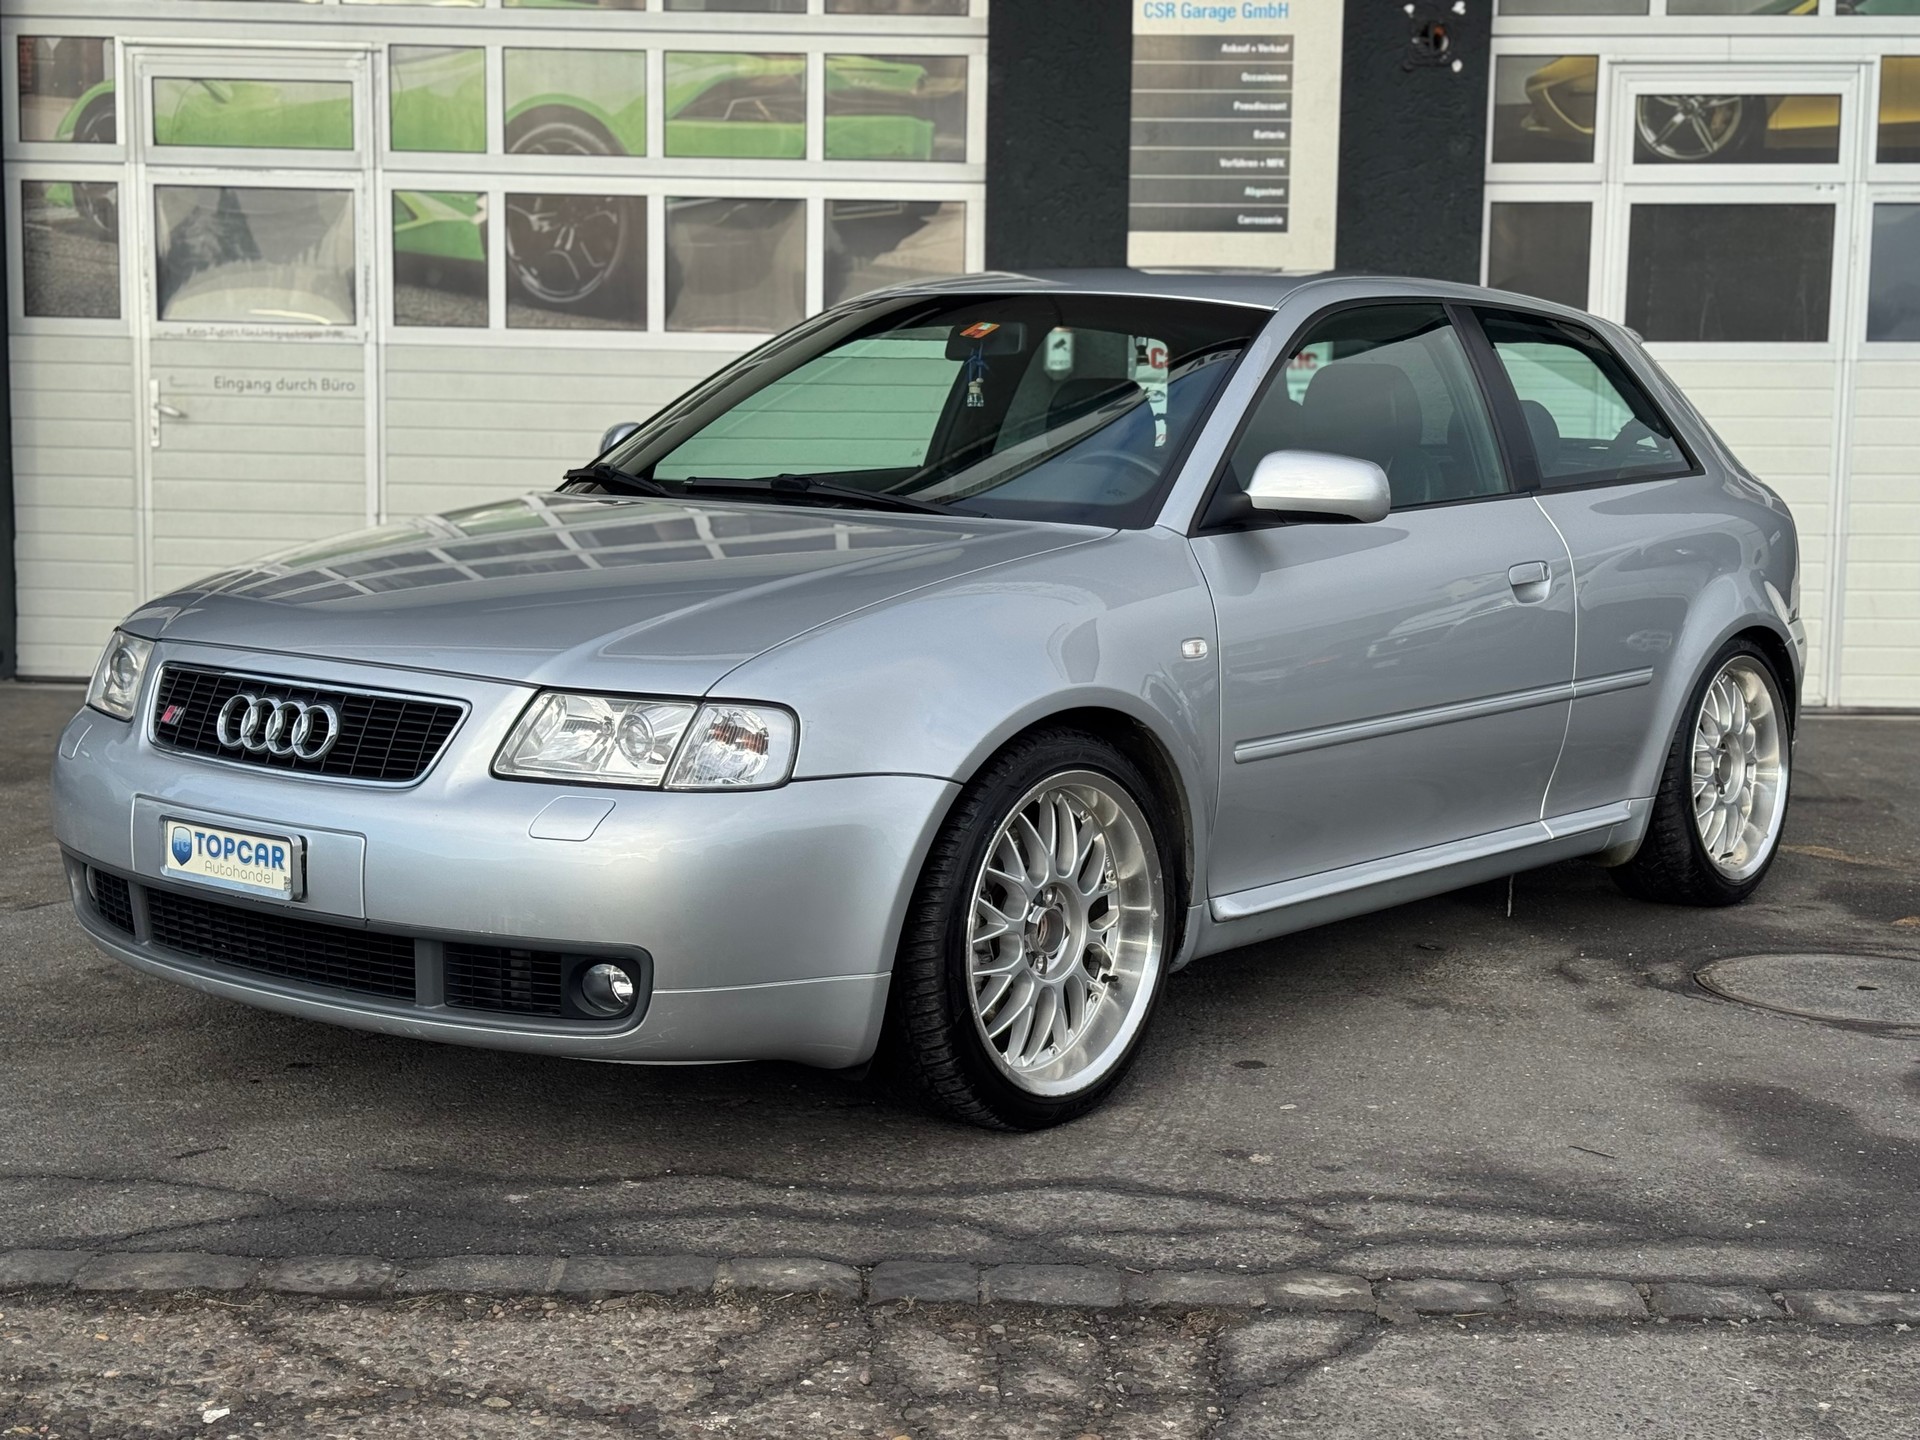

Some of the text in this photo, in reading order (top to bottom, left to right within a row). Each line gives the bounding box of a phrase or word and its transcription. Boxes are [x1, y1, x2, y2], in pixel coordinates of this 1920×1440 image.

[1143, 2, 1289, 22] CSR Garage GmbH
[1221, 43, 1250, 53] Ankauf
[1257, 43, 1289, 53] Verkauf
[1241, 72, 1288, 82] Occasionen
[214, 375, 356, 393] Eingang durch Büro
[194, 831, 286, 871] TOPCAR
[205, 860, 274, 885] Autohandel
